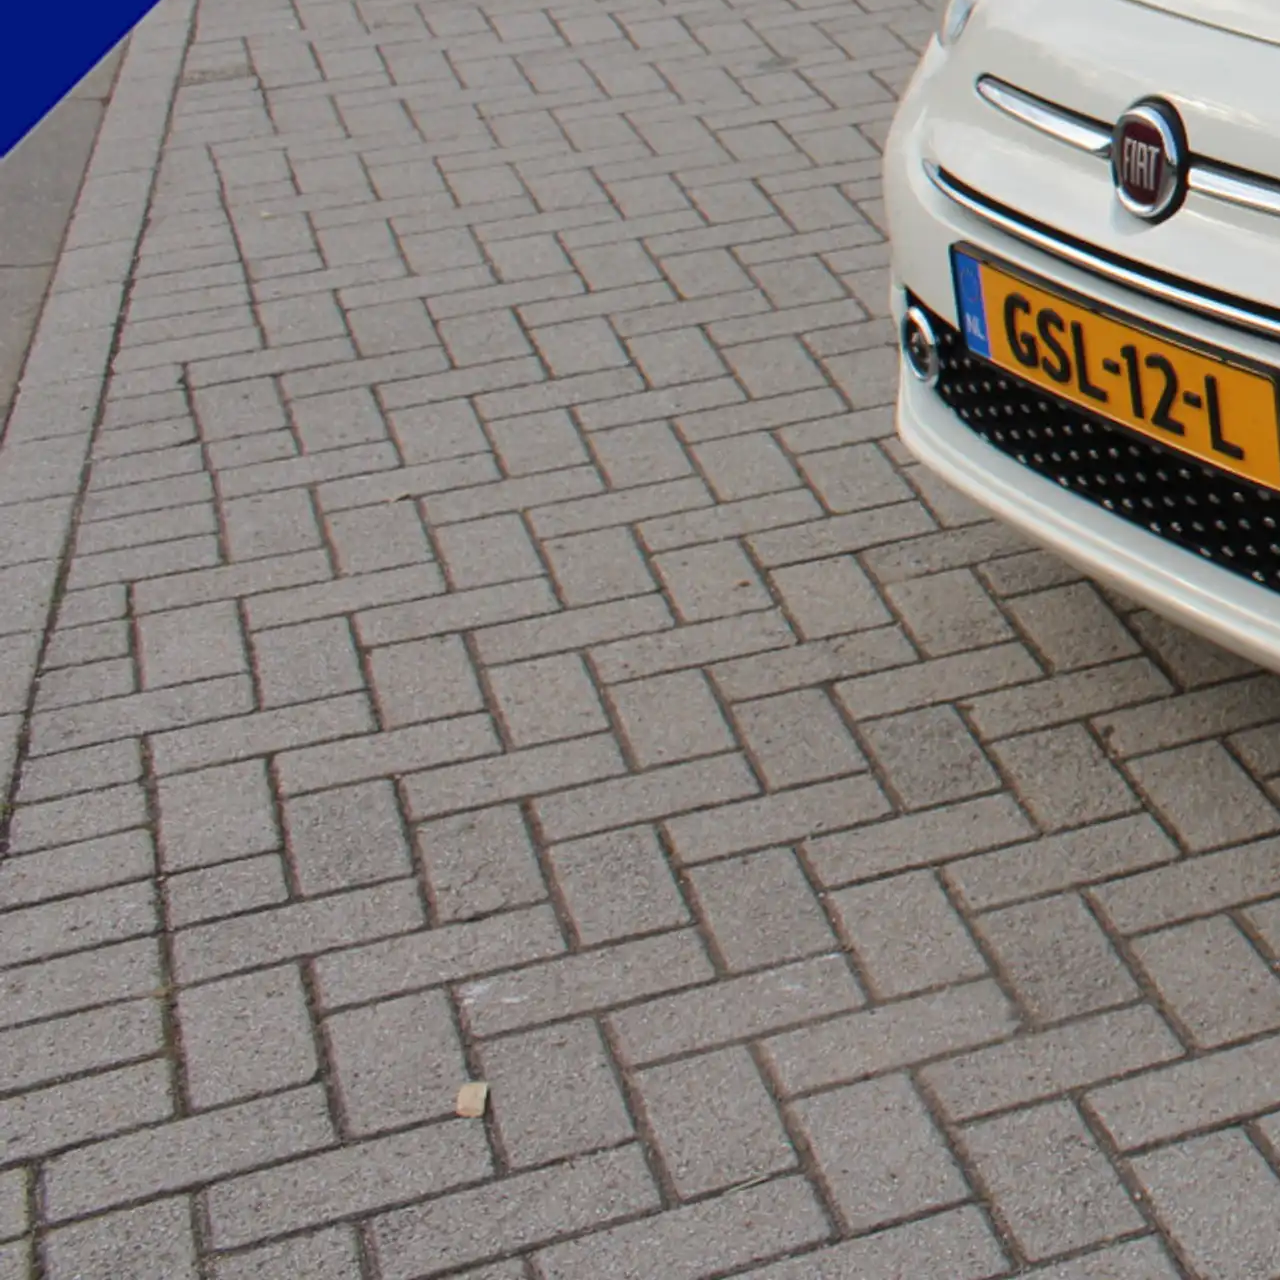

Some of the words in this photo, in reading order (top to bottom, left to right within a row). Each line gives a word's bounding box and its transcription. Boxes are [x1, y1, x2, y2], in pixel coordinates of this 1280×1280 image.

[1123, 137, 1161, 191] FIAT
[966, 314, 986, 342] NL
[1004, 292, 1244, 460] GSL-12-L
